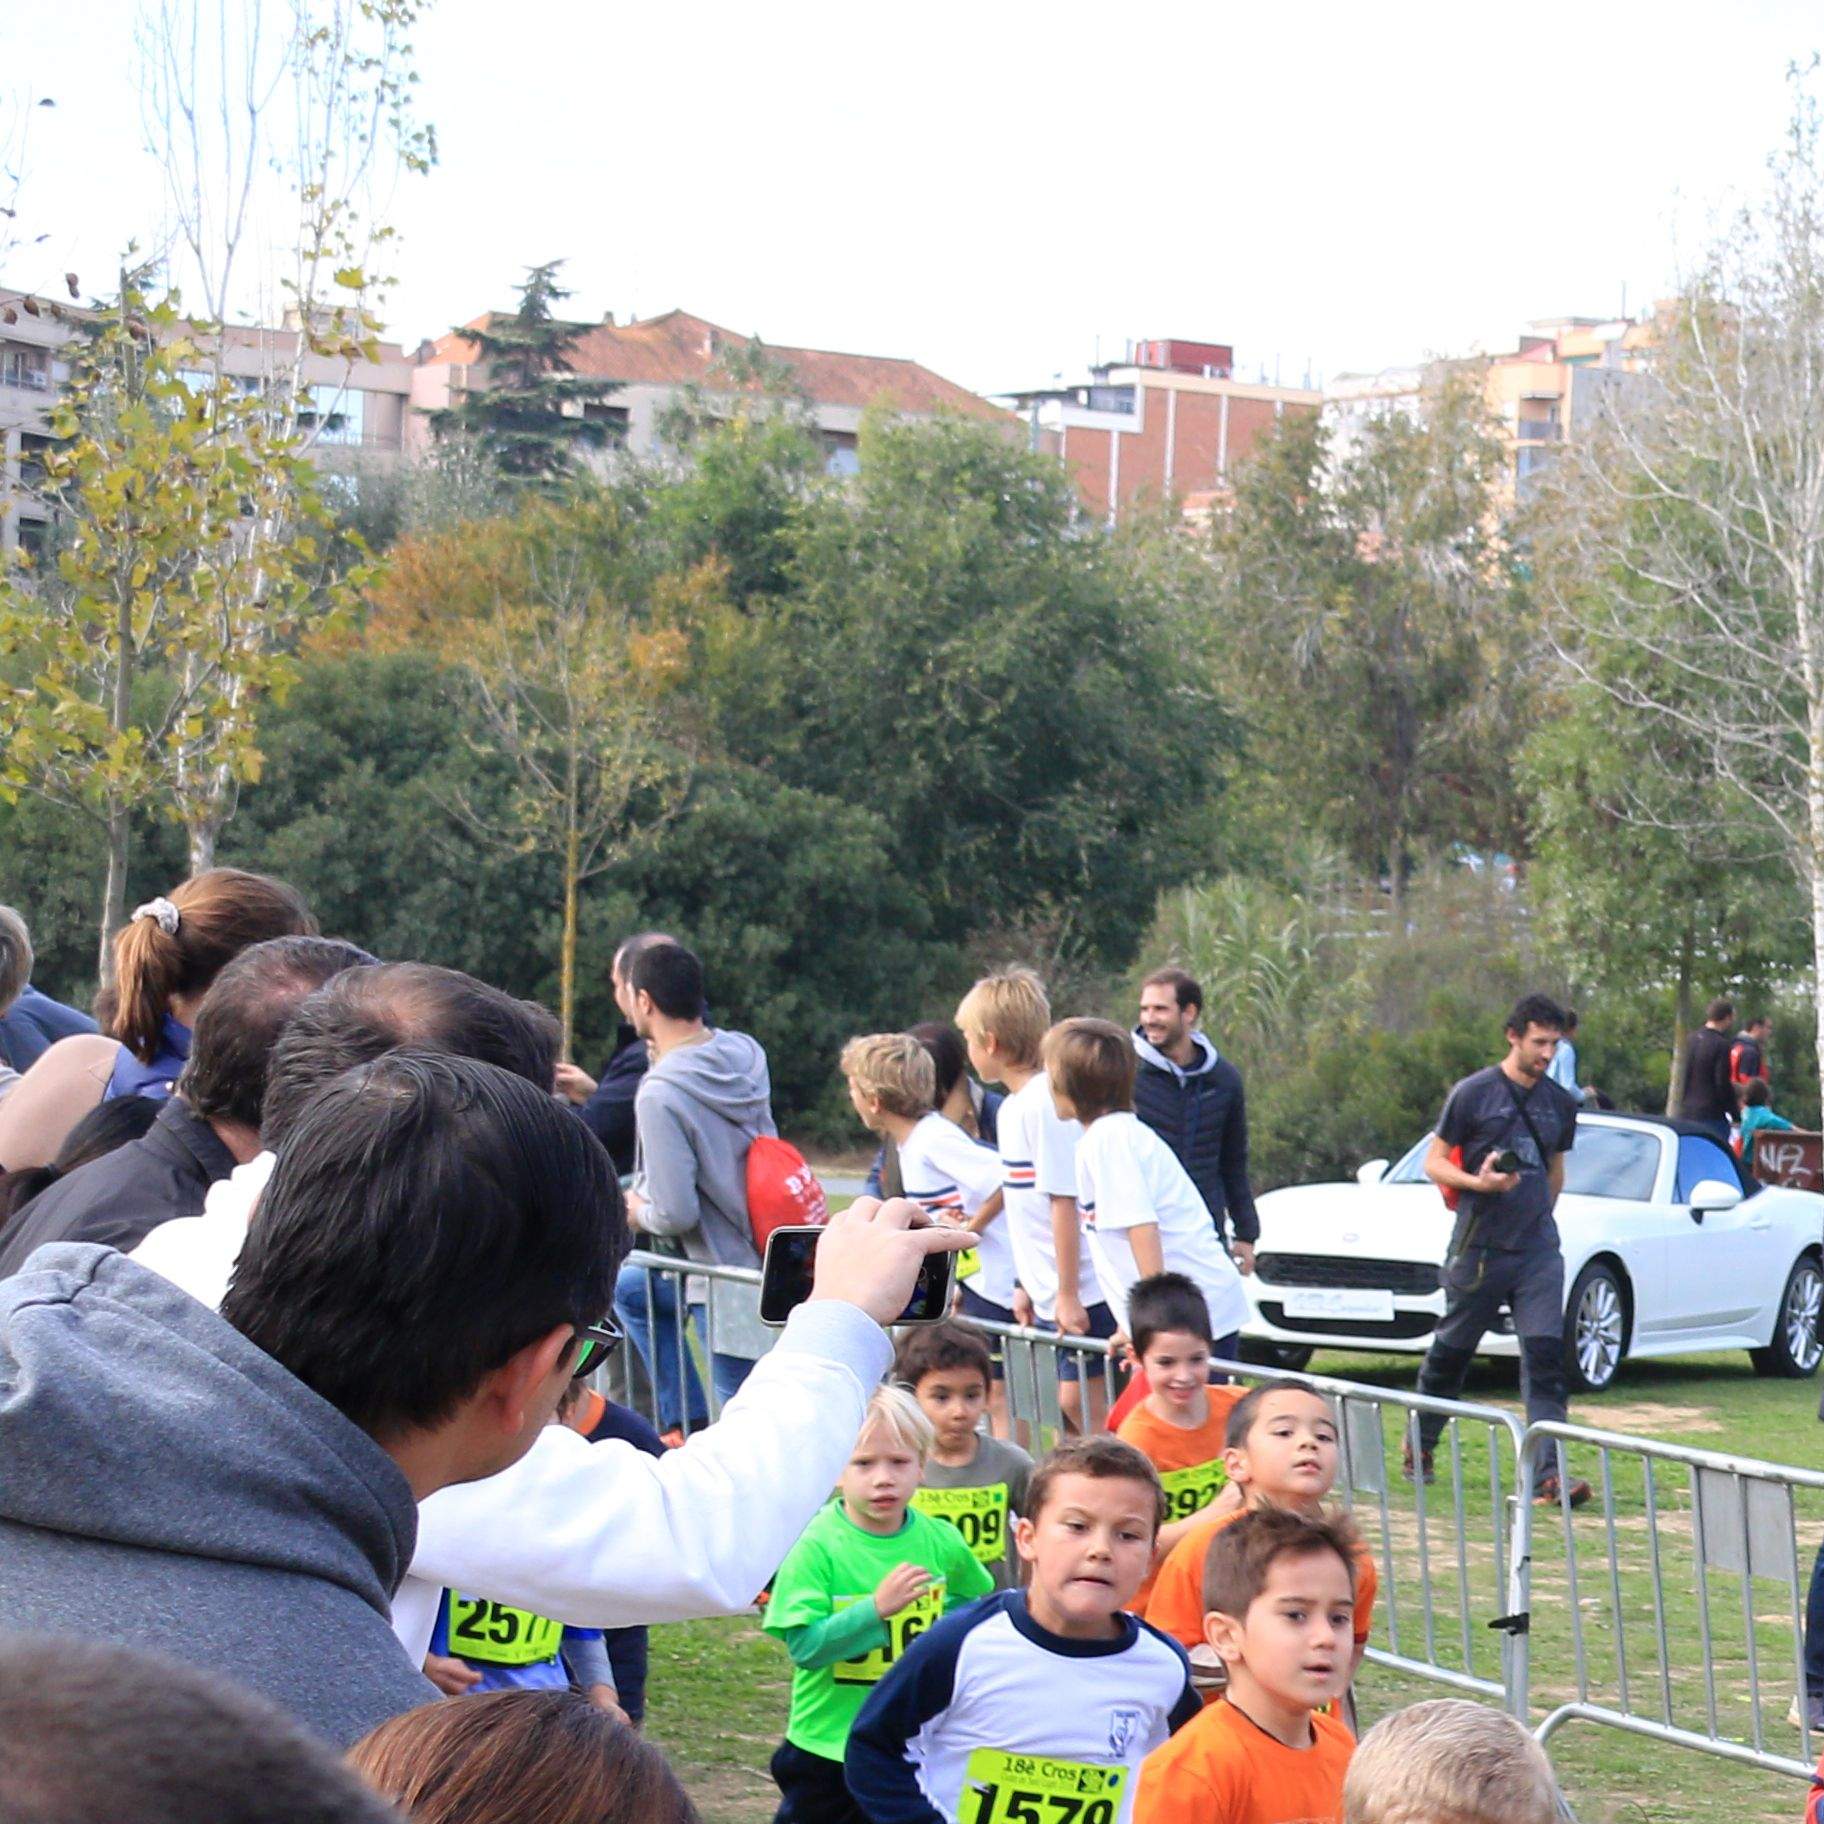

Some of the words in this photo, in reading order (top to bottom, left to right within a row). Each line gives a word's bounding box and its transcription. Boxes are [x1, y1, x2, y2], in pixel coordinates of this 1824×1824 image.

[932, 1508, 1000, 1549] 09
[1003, 1757, 1036, 1776] 18è
[1041, 1762, 1077, 1782] Cros
